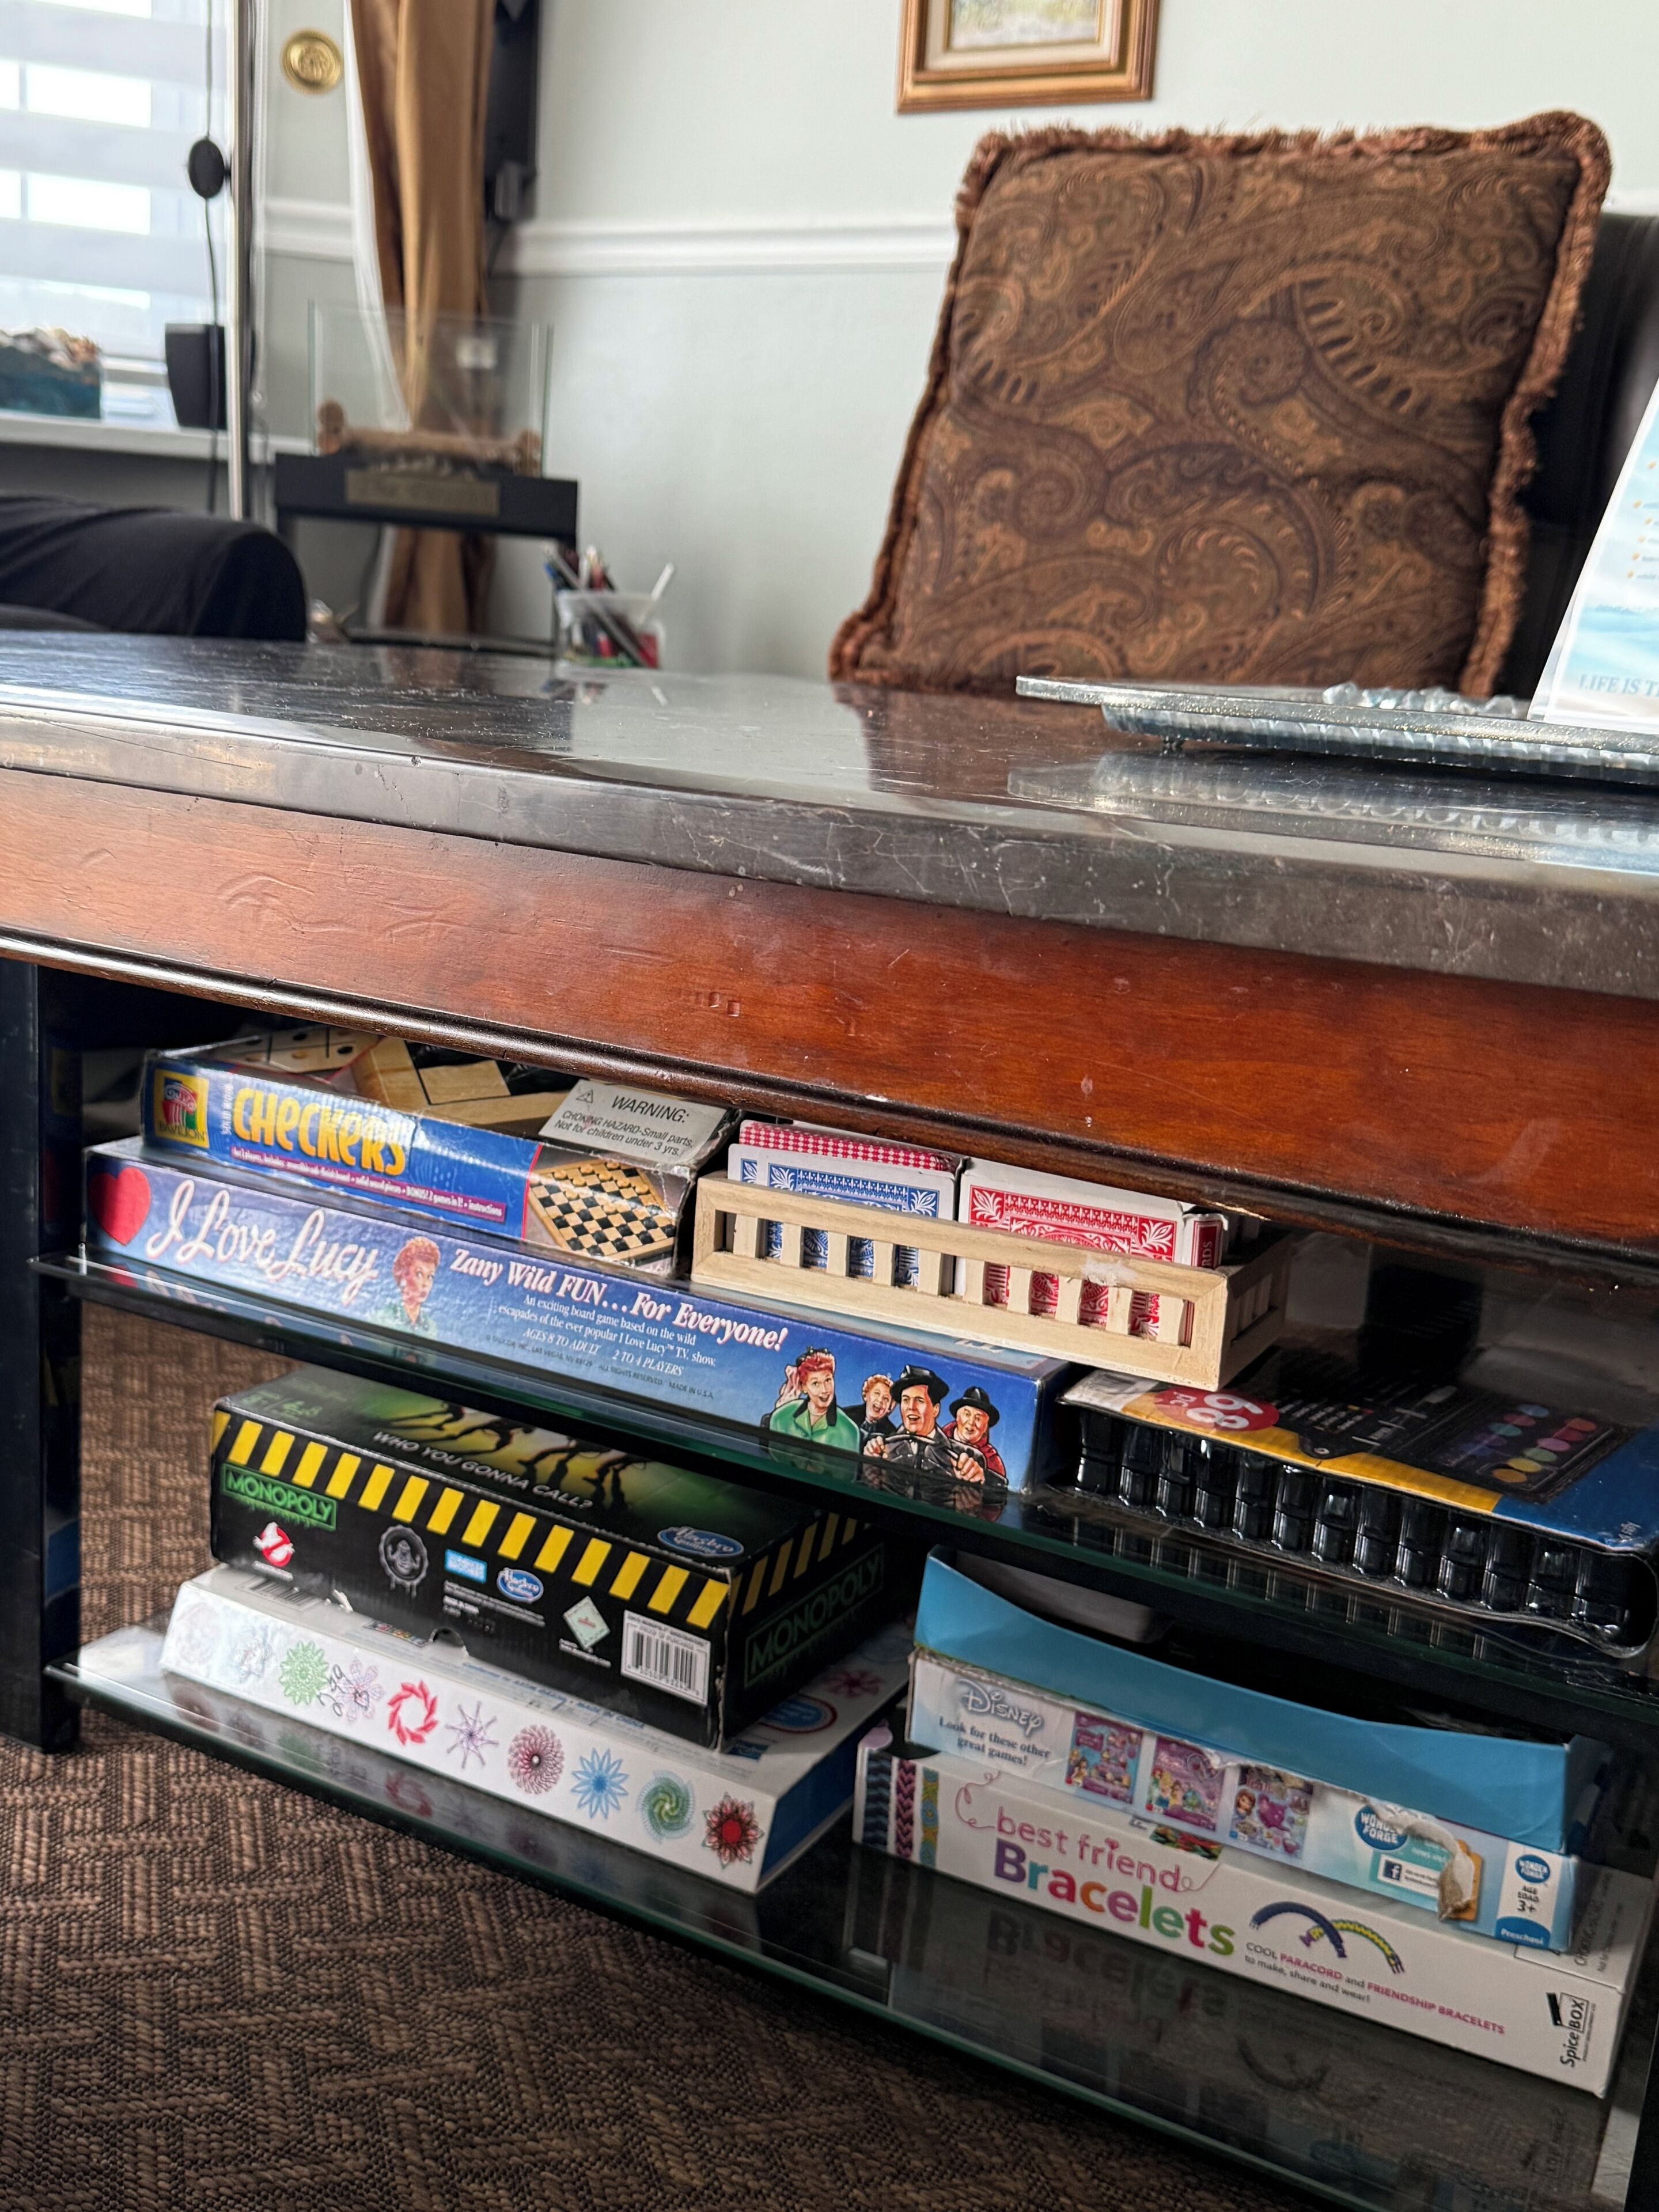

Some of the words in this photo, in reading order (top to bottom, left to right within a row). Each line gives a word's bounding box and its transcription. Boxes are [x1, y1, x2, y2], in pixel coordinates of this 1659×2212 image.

[1579, 674, 1619, 691] LIFE
[1622, 676, 1641, 695] IS
[562, 1111, 603, 1125] CHOKING
[612, 1096, 689, 1123] WARNING:
[555, 1119, 573, 1131] Not
[574, 1124, 585, 1133] for
[587, 1128, 624, 1141] children
[626, 1135, 653, 1148] under
[654, 1142, 663, 1151] 3
[662, 1145, 680, 1157] yrs.
[146, 1180, 195, 1260] I
[177, 1190, 276, 1268] Love
[268, 1210, 379, 1306] Lucy
[1202, 1241, 1212, 1267] RDS
[450, 1248, 503, 1286] Zany
[507, 1262, 556, 1294] Wild
[672, 1302, 788, 1351] Everyone!
[498, 1305, 538, 1323] escapades
[539, 1313, 550, 1324] of
[550, 1316, 564, 1328] the
[566, 1321, 584, 1332] ever
[584, 1326, 618, 1340] popular
[619, 1332, 623, 1343] I
[624, 1334, 645, 1349] Love
[692, 1351, 716, 1367] show.
[524, 1294, 536, 1306] An
[537, 1300, 569, 1317] exciting
[571, 1305, 595, 1320] board
[596, 1313, 619, 1325] game
[620, 1317, 645, 1334] based
[646, 1327, 658, 1336] on
[660, 1328, 675, 1340] the
[677, 1333, 696, 1346] wild
[523, 1328, 548, 1341] AGES
[548, 1332, 555, 1343] 8
[556, 1335, 569, 1347] TO
[570, 1340, 602, 1355] ADULT
[612, 1349, 620, 1360] 2
[621, 1351, 634, 1363] TO
[635, 1355, 642, 1366] 4
[642, 1357, 685, 1376] PLAYERS
[632, 1372, 663, 1386] RESERVED
[669, 1381, 688, 1392] MADE
[1185, 1393, 1263, 1429] 68
[374, 1431, 420, 1452] WHO
[421, 1447, 463, 1465] YOU
[461, 1461, 529, 1490] GONNA
[532, 1484, 593, 1510] CALL?
[227, 1473, 332, 1522] MONOPOLY
[668, 1527, 734, 1552] Hasbro
[498, 1567, 540, 1592] Hasbro
[751, 1552, 879, 1674] MONOPOLY
[939, 1715, 967, 1733] Look
[970, 1725, 987, 1739] for
[989, 1732, 1018, 1749] these
[1020, 1743, 1052, 1758] other
[957, 1737, 986, 1753] great
[988, 1747, 1029, 1766] games!
[997, 1806, 1069, 1854] best
[1078, 1832, 1183, 1892] friend
[1363, 1824, 1398, 1844] FORGE
[994, 1838, 1235, 1956] Bracelets
[1517, 1900, 1536, 1912] 3+
[1518, 1891, 1539, 1903] EDAD
[1522, 1885, 1537, 1895] AGE
[1245, 1955, 1255, 1965] to
[1257, 1960, 1287, 1976] make,
[1290, 1971, 1317, 1985] share
[1320, 1980, 1339, 1993] and
[1342, 1989, 1370, 2003] wear!
[1246, 1942, 1278, 1959] COOL
[1279, 1953, 1343, 1980] PARACORD
[1345, 1976, 1366, 1988] and
[1368, 1982, 1437, 2010] FRIENDSHIP
[1438, 2005, 1505, 2034] BRACELETS
